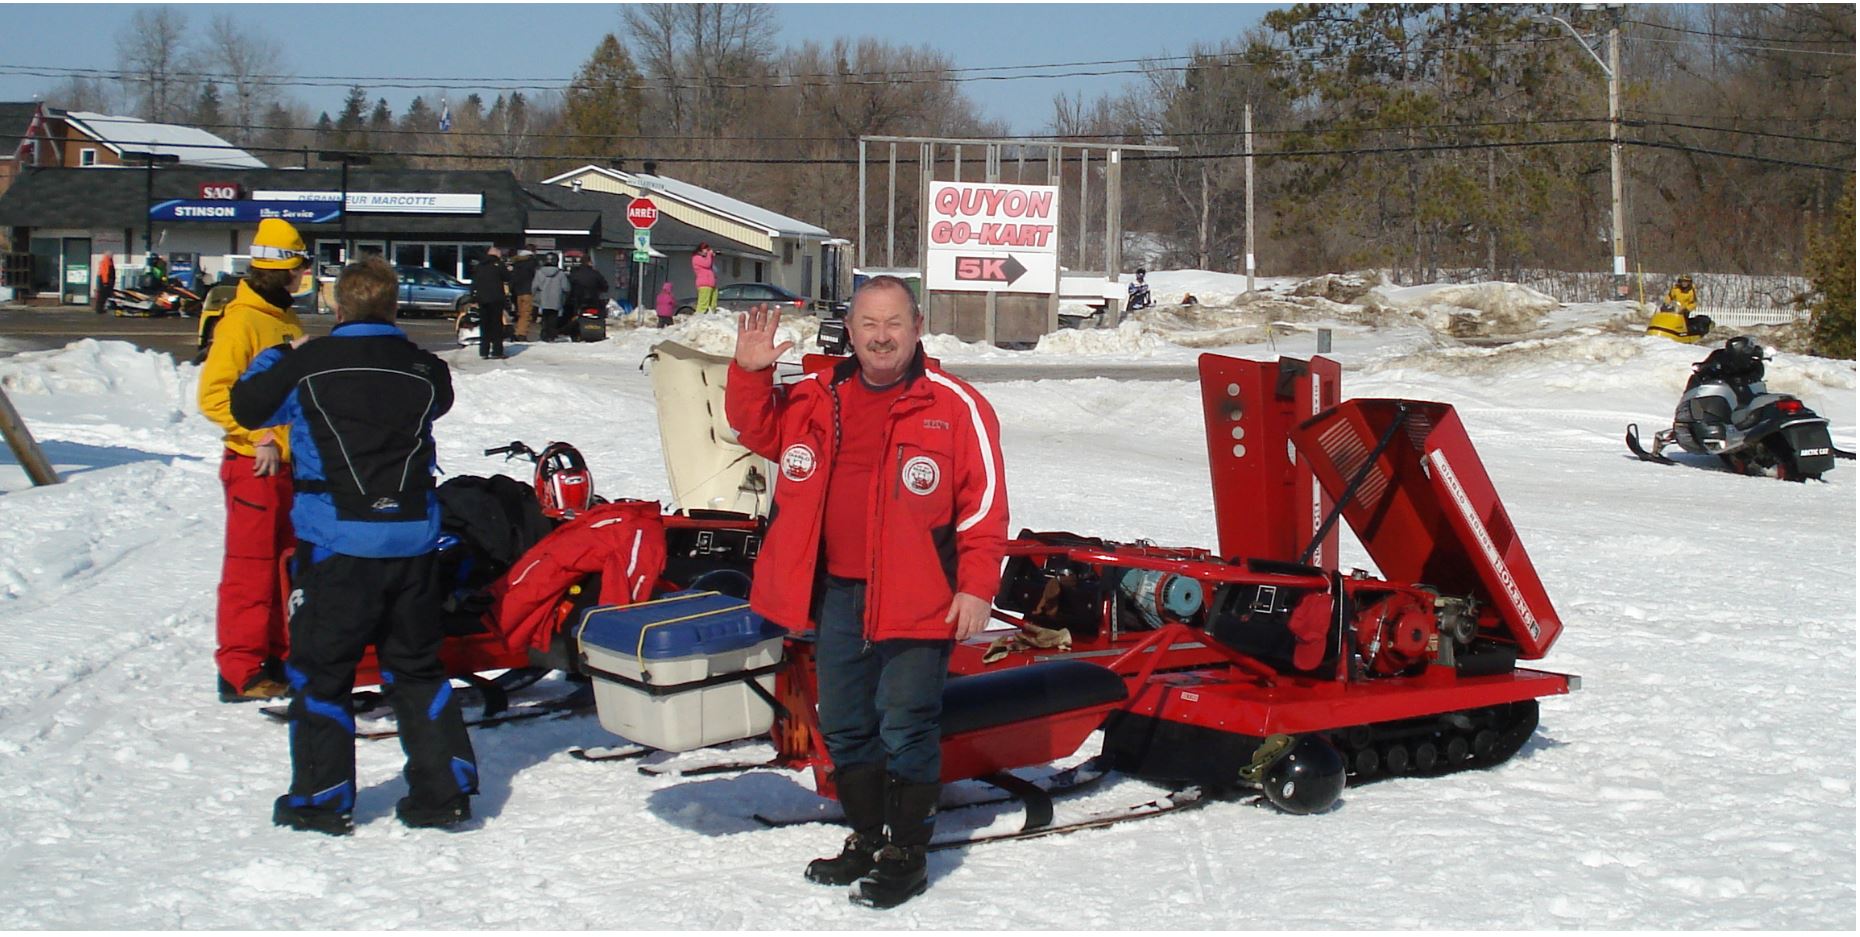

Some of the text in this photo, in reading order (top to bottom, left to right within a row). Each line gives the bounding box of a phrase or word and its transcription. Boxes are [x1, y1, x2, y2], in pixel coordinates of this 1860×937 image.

[203, 186, 236, 200] SAQ
[372, 195, 436, 206] MARCOTTE
[935, 187, 1053, 218] QUYON
[174, 206, 235, 217] STINSON
[629, 207, 657, 218] ARRÊT
[931, 220, 1054, 247] GO-KART
[957, 257, 1007, 280] 5K
